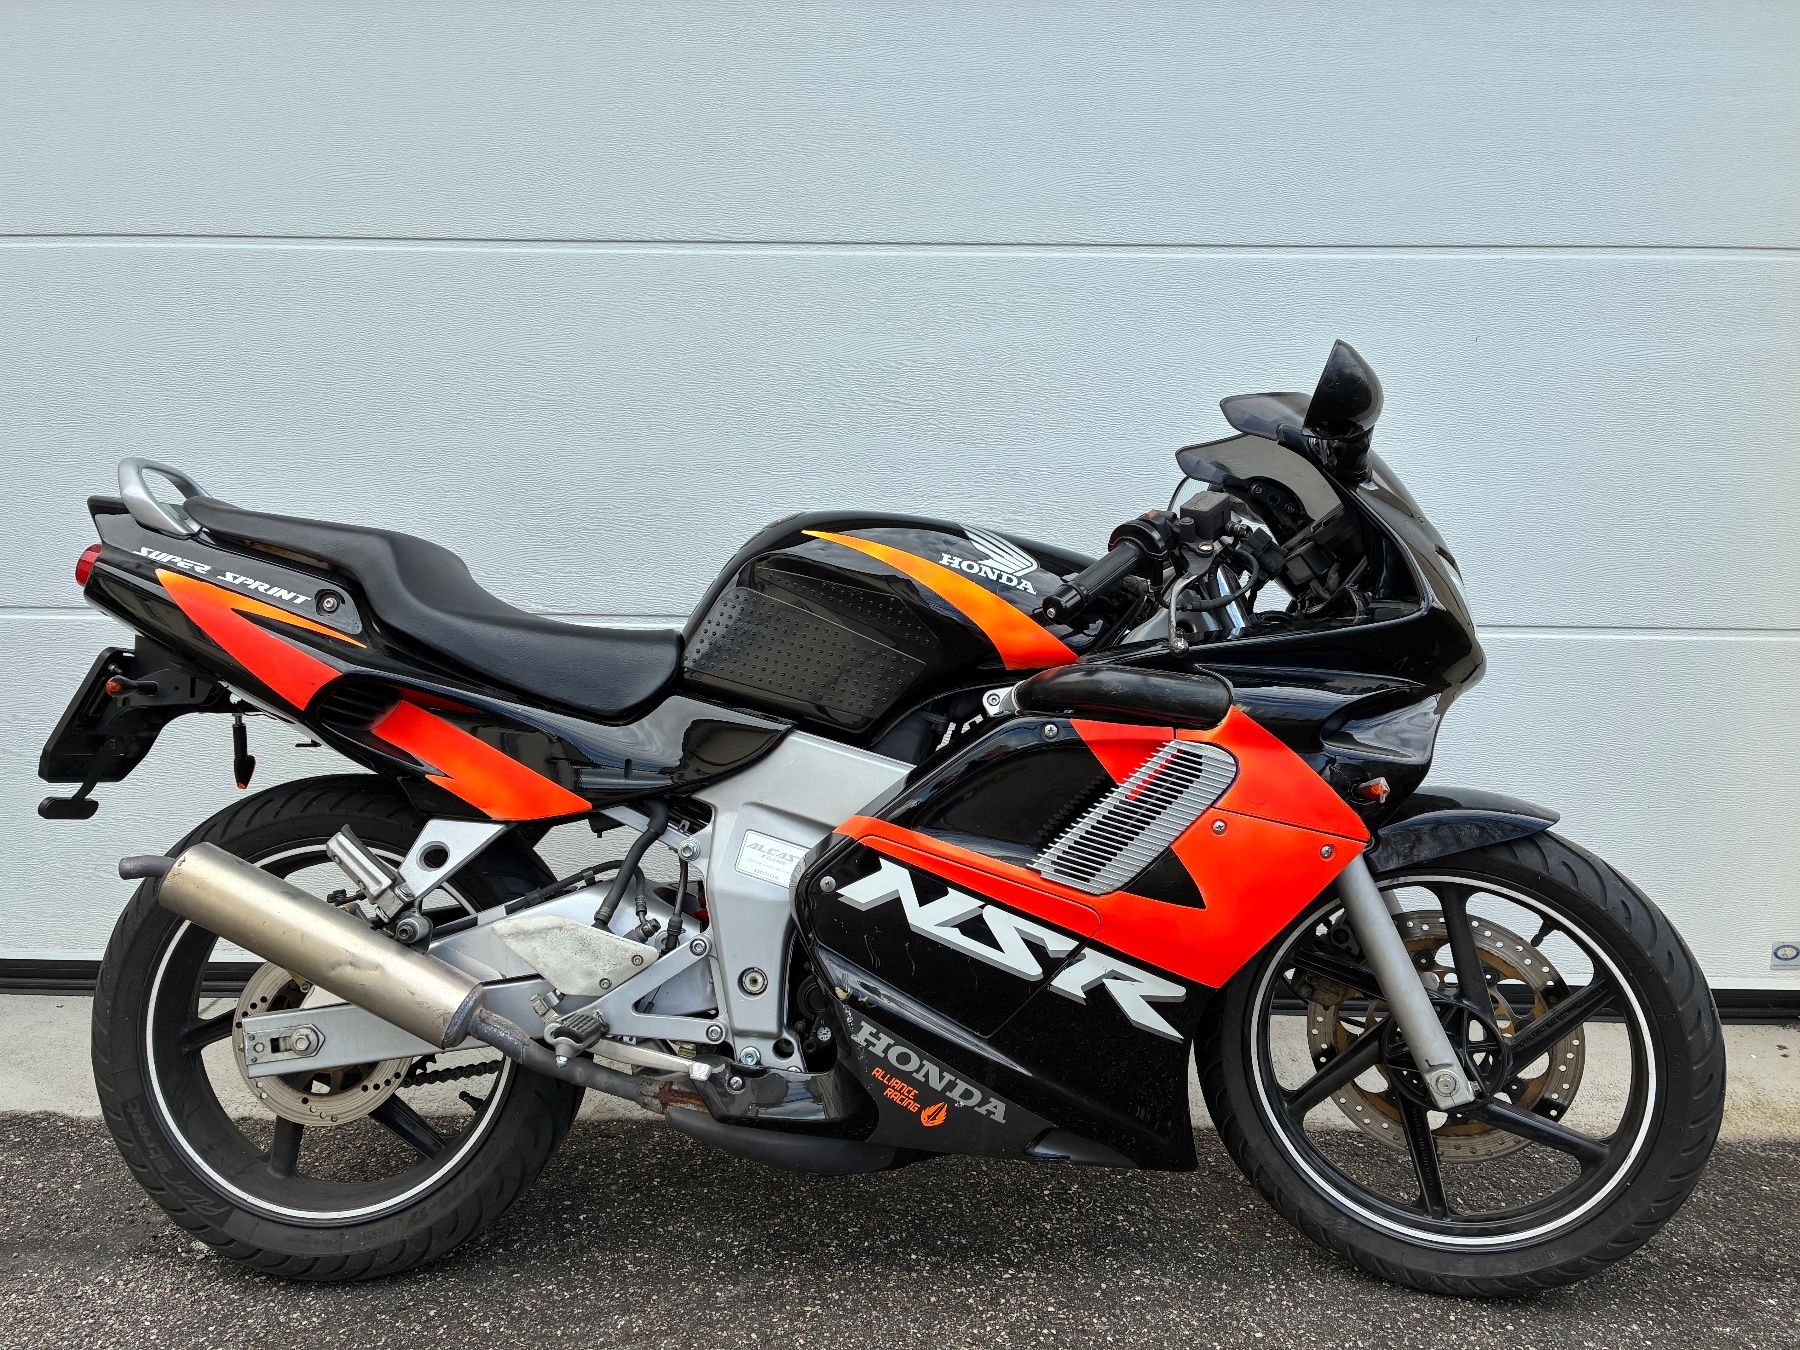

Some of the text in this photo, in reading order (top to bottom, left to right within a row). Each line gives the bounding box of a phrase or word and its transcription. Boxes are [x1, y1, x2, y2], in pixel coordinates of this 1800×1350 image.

[132, 546, 312, 605] SUPER SPRINT
[939, 552, 1037, 595] HONDA
[746, 842, 801, 863] ALCAS
[836, 857, 1187, 1044] NSR
[851, 1021, 1007, 1124] HONDA
[871, 1066, 919, 1100] ALLIANCE
[883, 1087, 921, 1113] RACING
